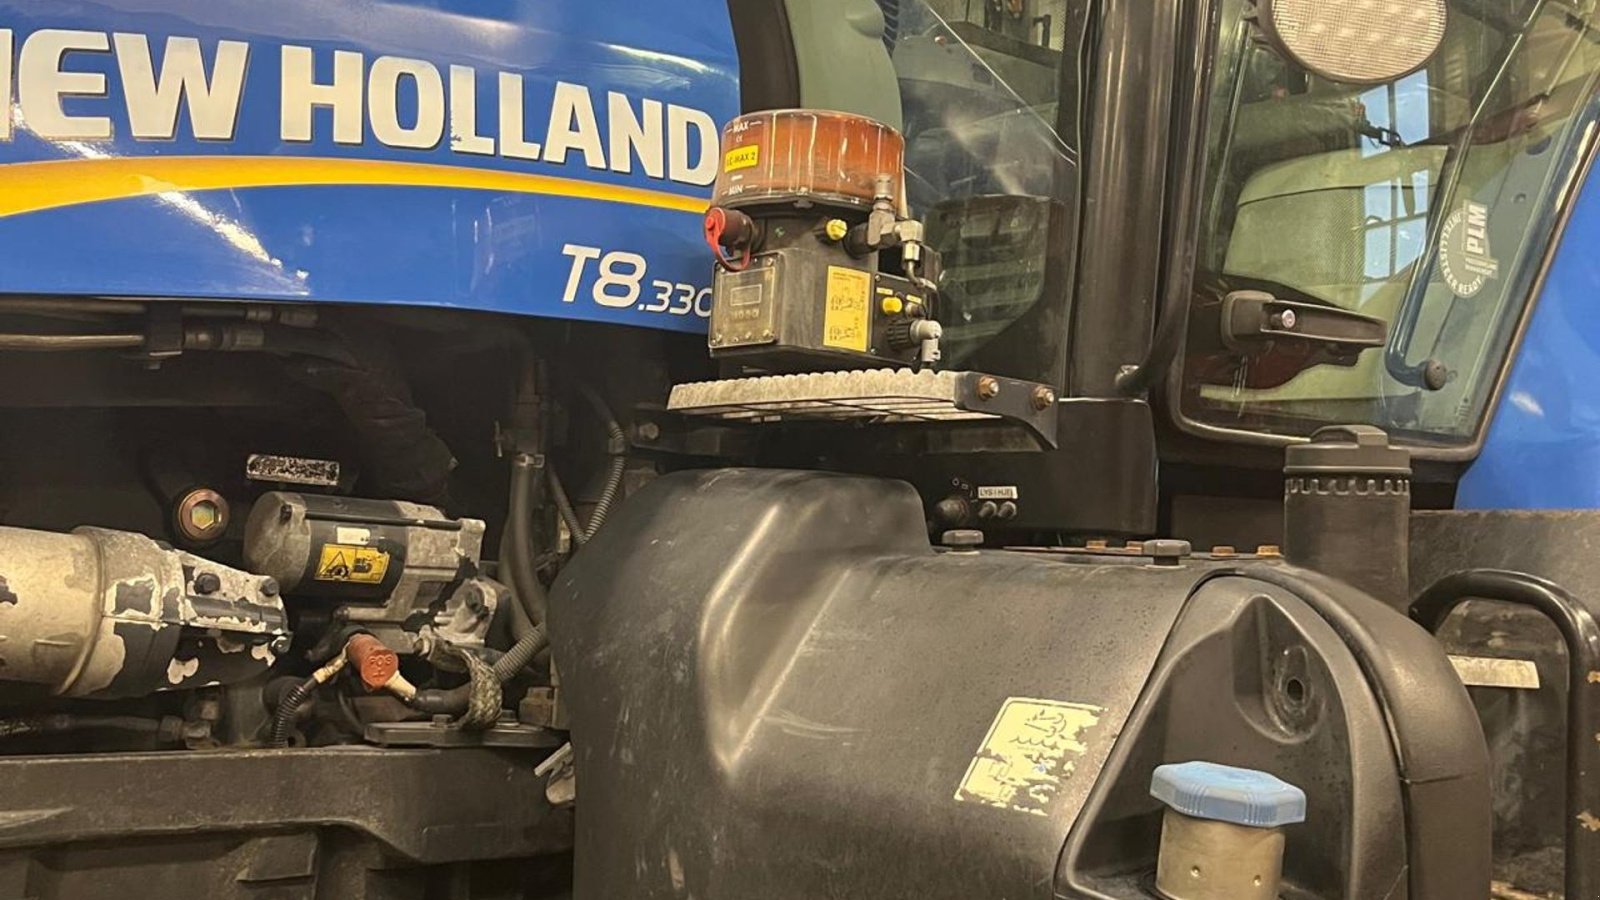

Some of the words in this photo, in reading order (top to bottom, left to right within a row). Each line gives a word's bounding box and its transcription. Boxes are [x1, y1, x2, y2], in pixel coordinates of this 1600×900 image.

[0, 29, 248, 140] EW
[281, 45, 719, 185] HOLLAND
[1466, 204, 1486, 254] PLM
[562, 244, 712, 318] T8.330
[1458, 275, 1483, 295] READY
